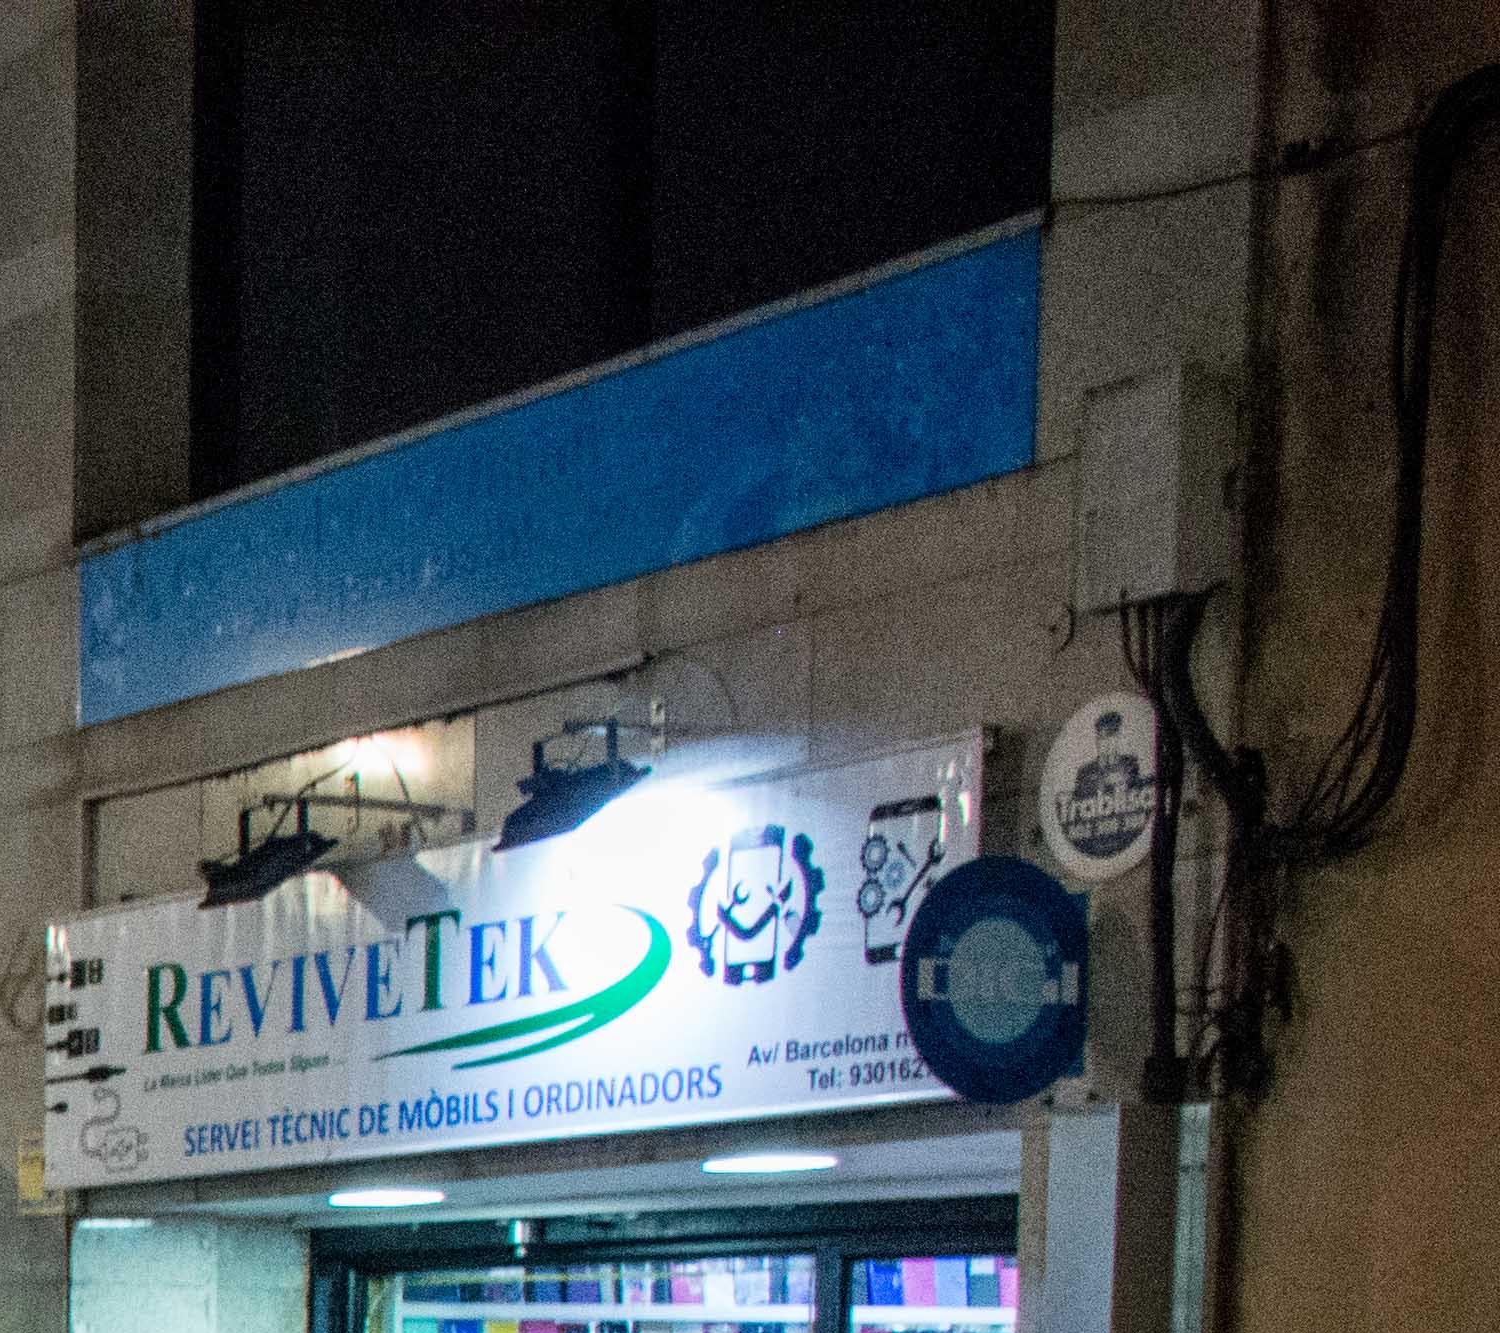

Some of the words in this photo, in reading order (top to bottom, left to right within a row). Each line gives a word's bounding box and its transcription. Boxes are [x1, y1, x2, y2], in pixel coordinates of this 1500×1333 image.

[785, 1034, 890, 1063] Barcelona
[184, 1119, 261, 1158] SERVEI
[266, 1105, 351, 1150] TÈCNIC
[358, 1102, 390, 1137] DE
[398, 1086, 499, 1131] MÒBILS
[509, 1091, 515, 1121] I
[523, 1062, 723, 1118] ORDINADORS
